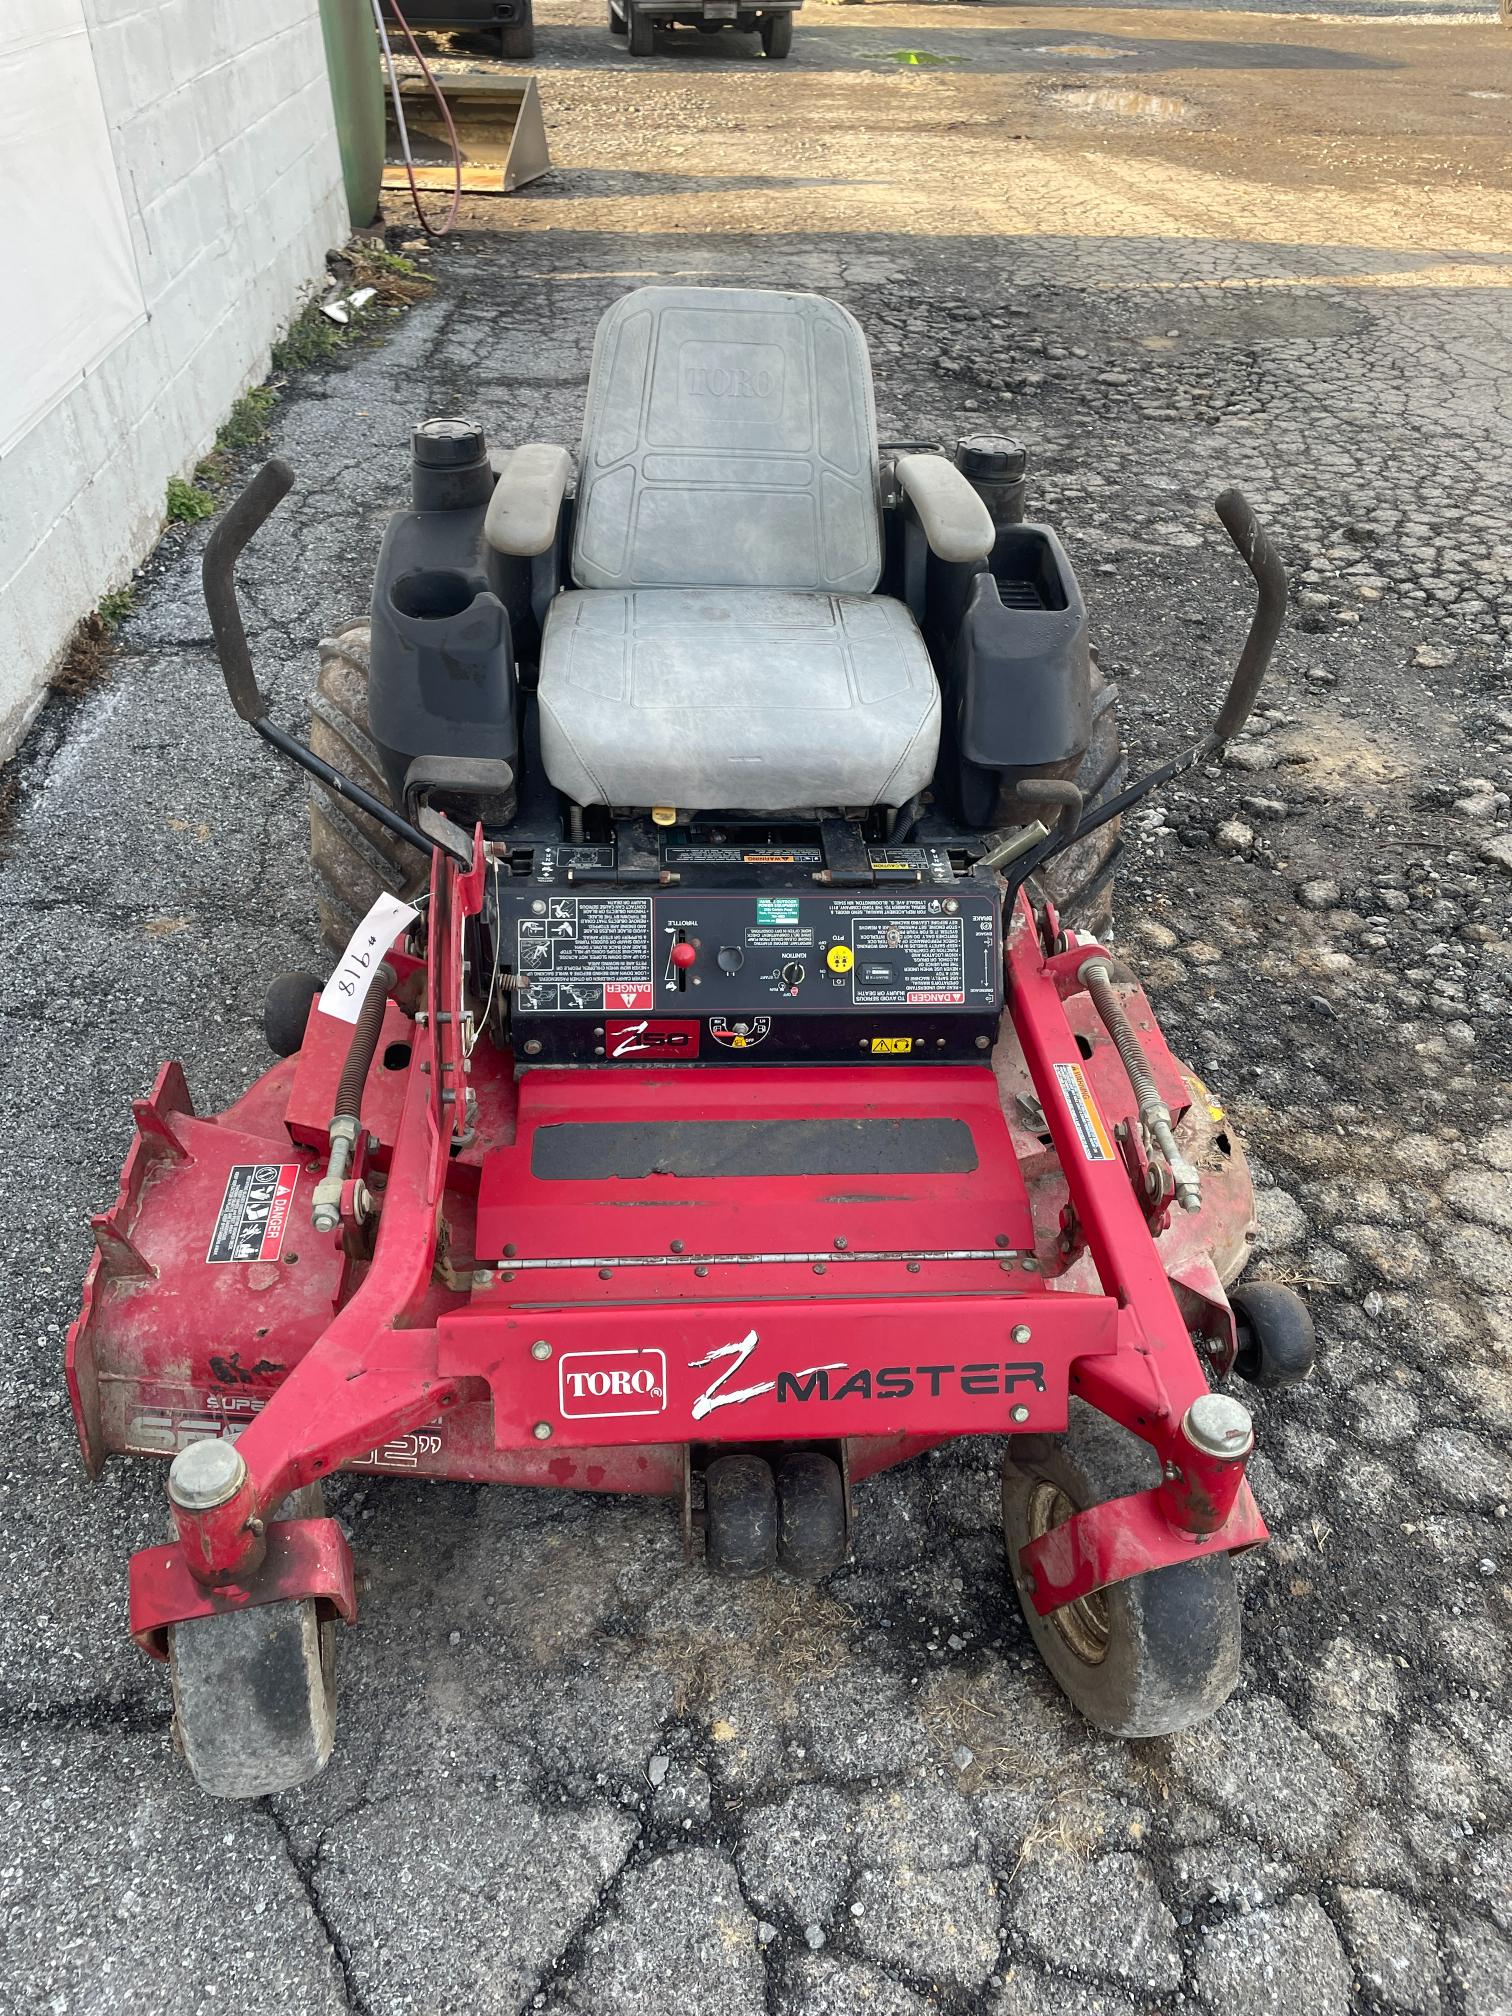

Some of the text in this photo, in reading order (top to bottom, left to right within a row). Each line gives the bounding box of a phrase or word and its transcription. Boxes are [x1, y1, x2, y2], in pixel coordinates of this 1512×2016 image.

[686, 365, 776, 399] TORO
[606, 984, 650, 992] DANGER
[911, 993, 951, 1001] DANGER
[265, 1197, 288, 1241] DANGER
[566, 1367, 652, 1398] TORO
[776, 1361, 1044, 1404] MASTER
